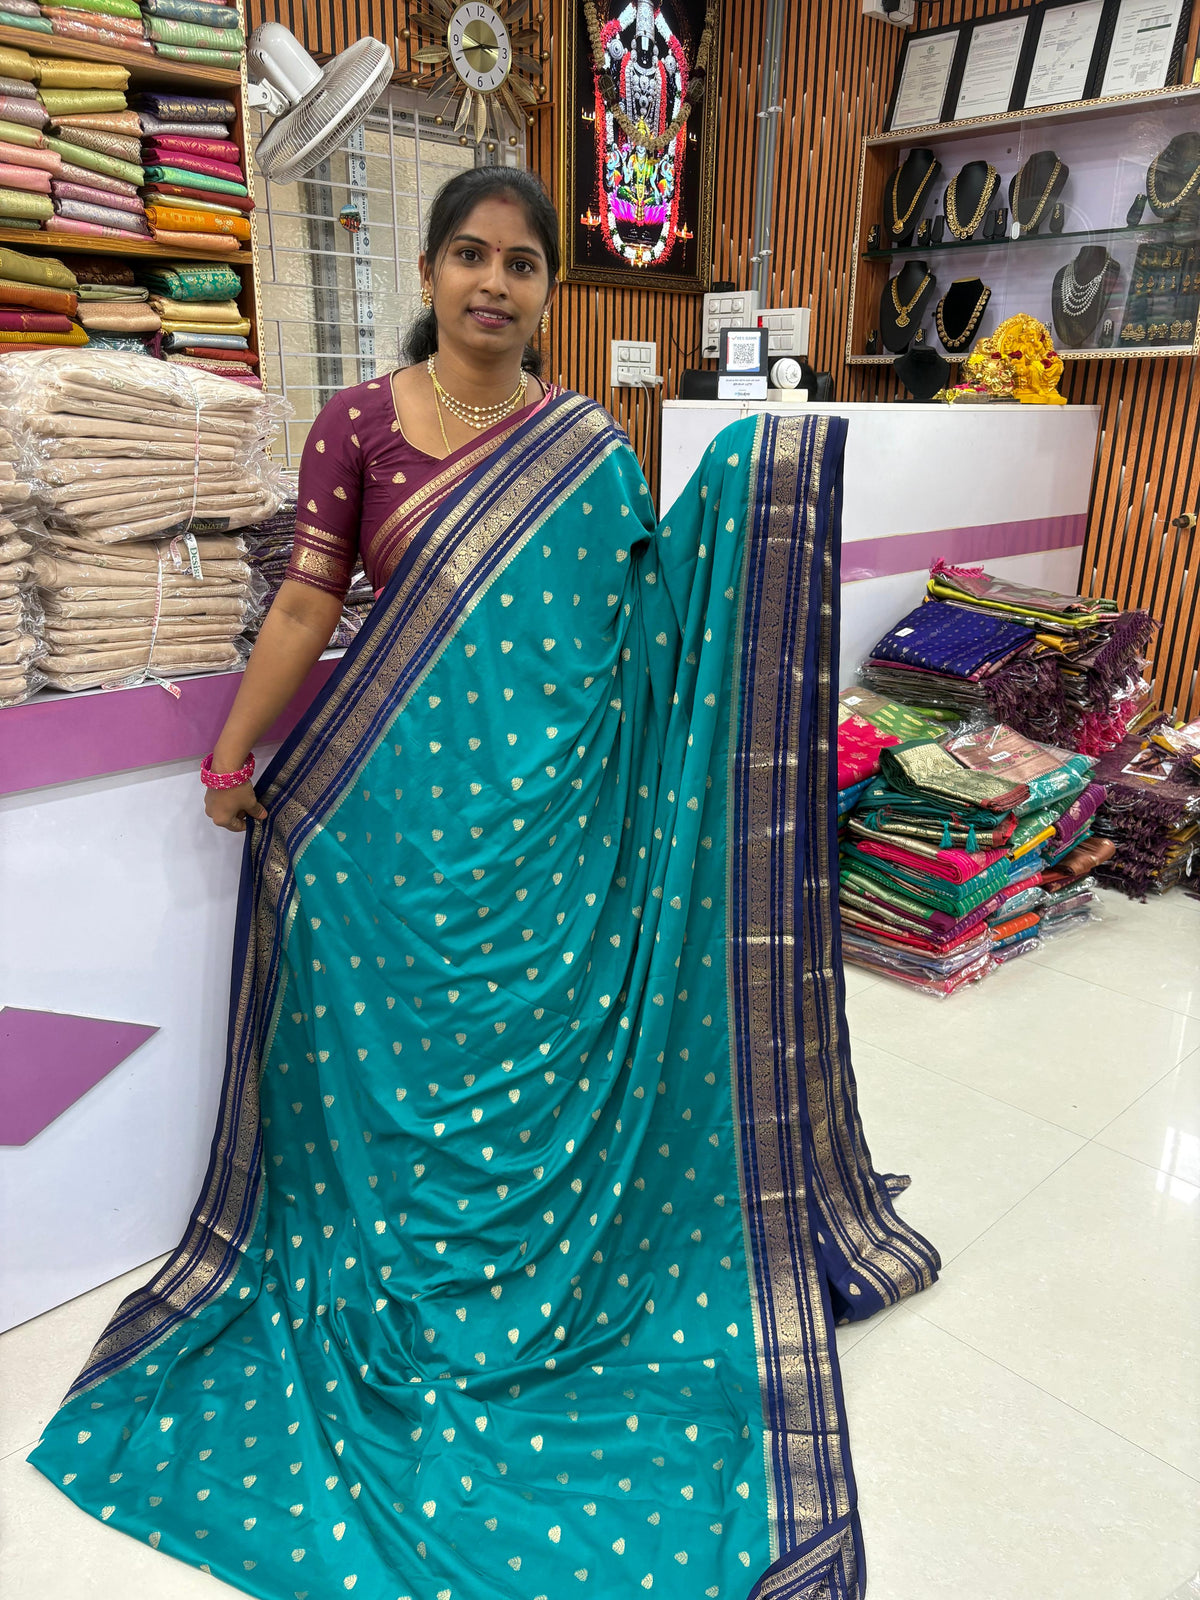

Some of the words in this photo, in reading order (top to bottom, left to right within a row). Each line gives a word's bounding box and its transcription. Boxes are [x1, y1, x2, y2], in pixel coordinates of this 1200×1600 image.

[477, 5, 485, 18] 12
[453, 34, 459, 46] 9
[502, 48, 508, 60] 3
[477, 76, 483, 88] 6
